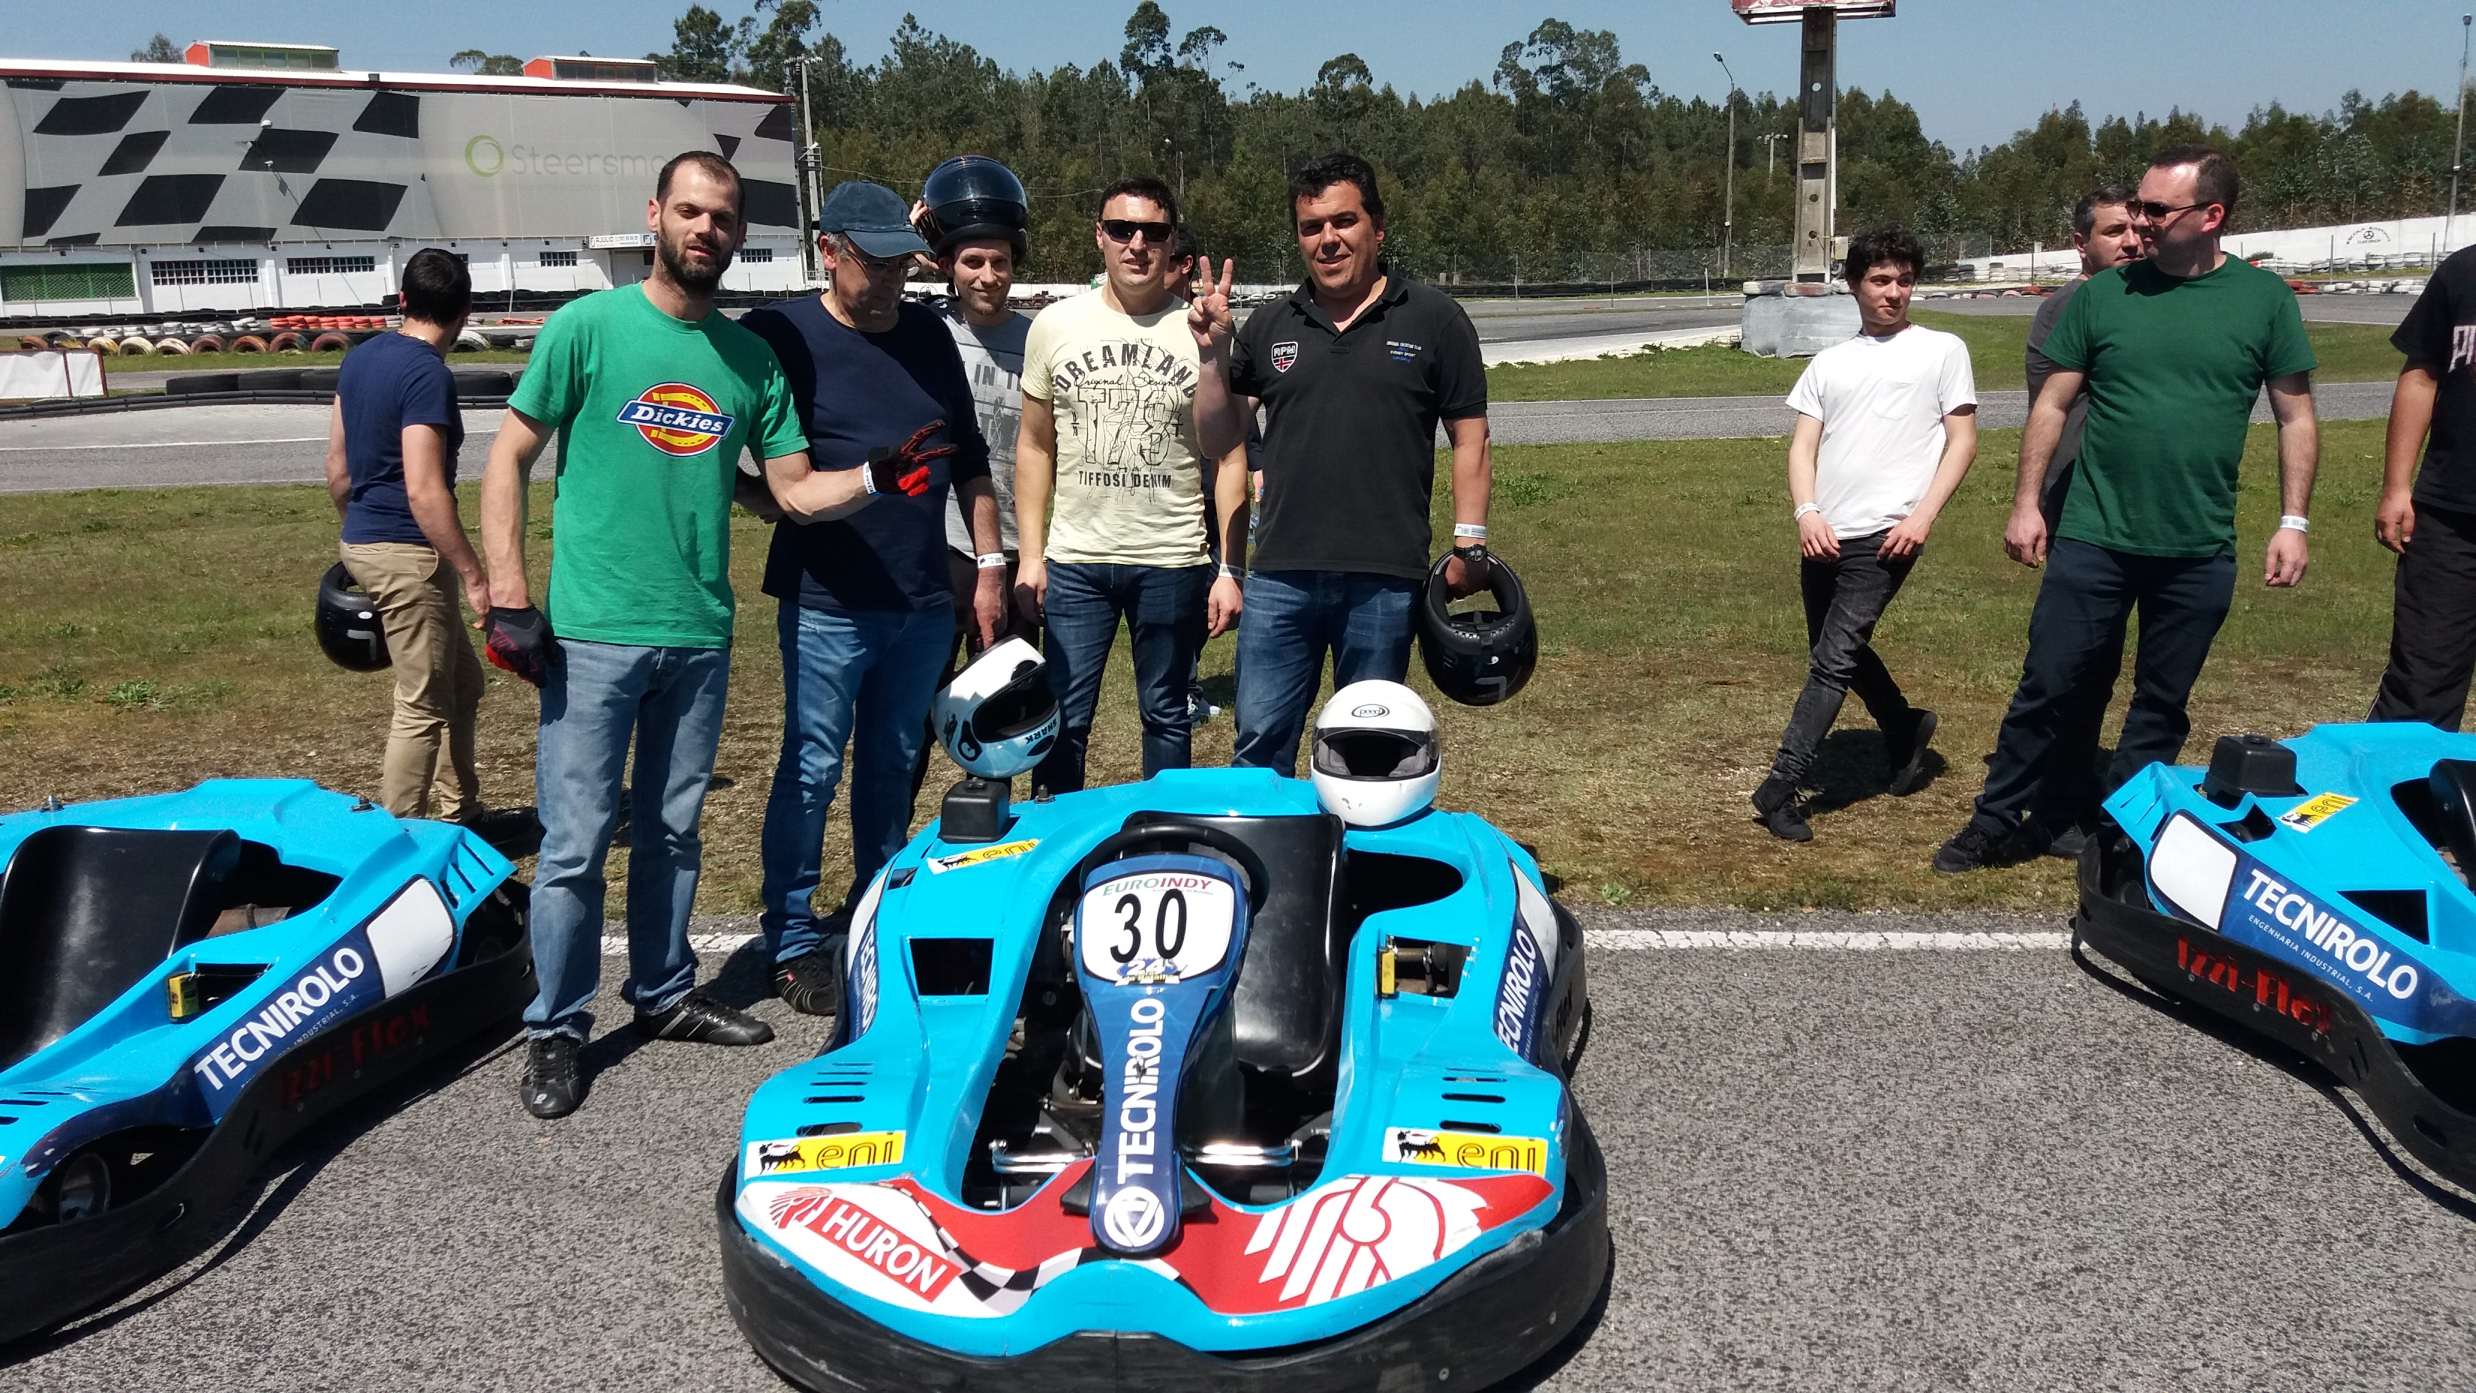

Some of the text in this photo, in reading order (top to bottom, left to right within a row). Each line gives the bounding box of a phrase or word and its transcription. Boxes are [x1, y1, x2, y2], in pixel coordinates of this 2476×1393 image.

[630, 404, 724, 433] Dickies
[1079, 471, 1172, 488] TIFFOSI DENIM
[1103, 877, 1213, 896] EUROINDY
[1109, 888, 1187, 964] 30
[2243, 868, 2419, 1000] TECNIROLO
[2248, 914, 2374, 1002] ENGENHARIA INDUSTRIAL, S.A.
[193, 947, 365, 1091] TECNIROLO
[1117, 998, 1166, 1184] TECNIROLO
[816, 1131, 894, 1170] eni
[1456, 1138, 1536, 1173] eni
[822, 1203, 948, 1294] HURON
